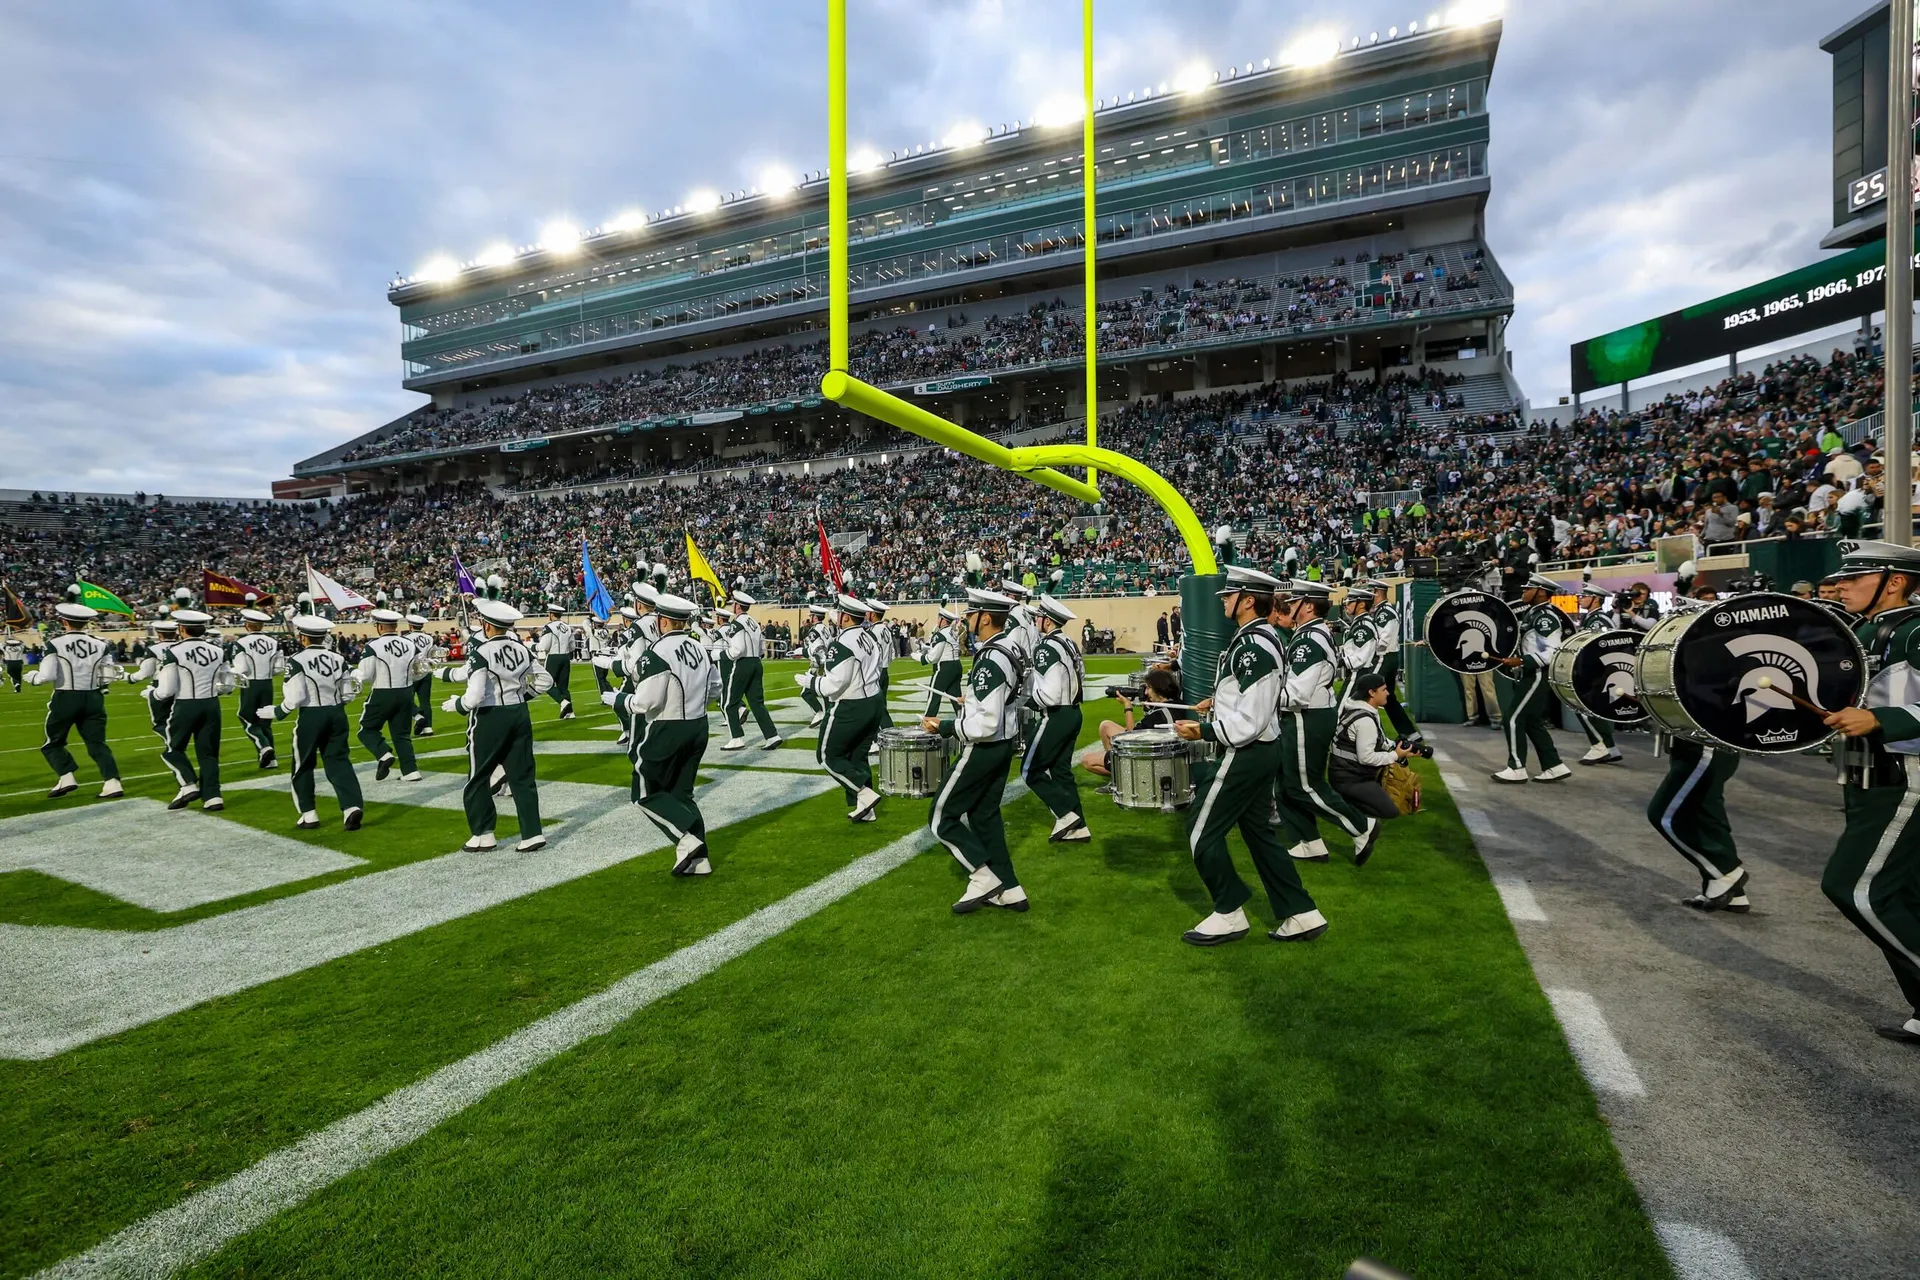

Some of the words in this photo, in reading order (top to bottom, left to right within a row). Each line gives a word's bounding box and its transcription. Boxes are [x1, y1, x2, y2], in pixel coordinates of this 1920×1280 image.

[1853, 173, 1885, 205] 25
[1722, 308, 1761, 330] 1953,
[1763, 293, 1804, 317] 1965,
[1806, 278, 1852, 304] 1966,
[1855, 265, 1887, 288] 197
[937, 380, 983, 391] DAUGHERTY
[1459, 595, 1485, 605] YAMAHA
[1731, 604, 1790, 624] YAMAHA
[65, 639, 98, 660] MSU
[249, 638, 273, 655] MSU
[384, 639, 409, 658] MSU
[1606, 637, 1634, 647] YAMAHA
[185, 646, 219, 667] MSU
[308, 653, 340, 677] MSU
[494, 644, 525, 672] MSU
[675, 640, 704, 670] MSU
[1763, 734, 1794, 742] REMO
